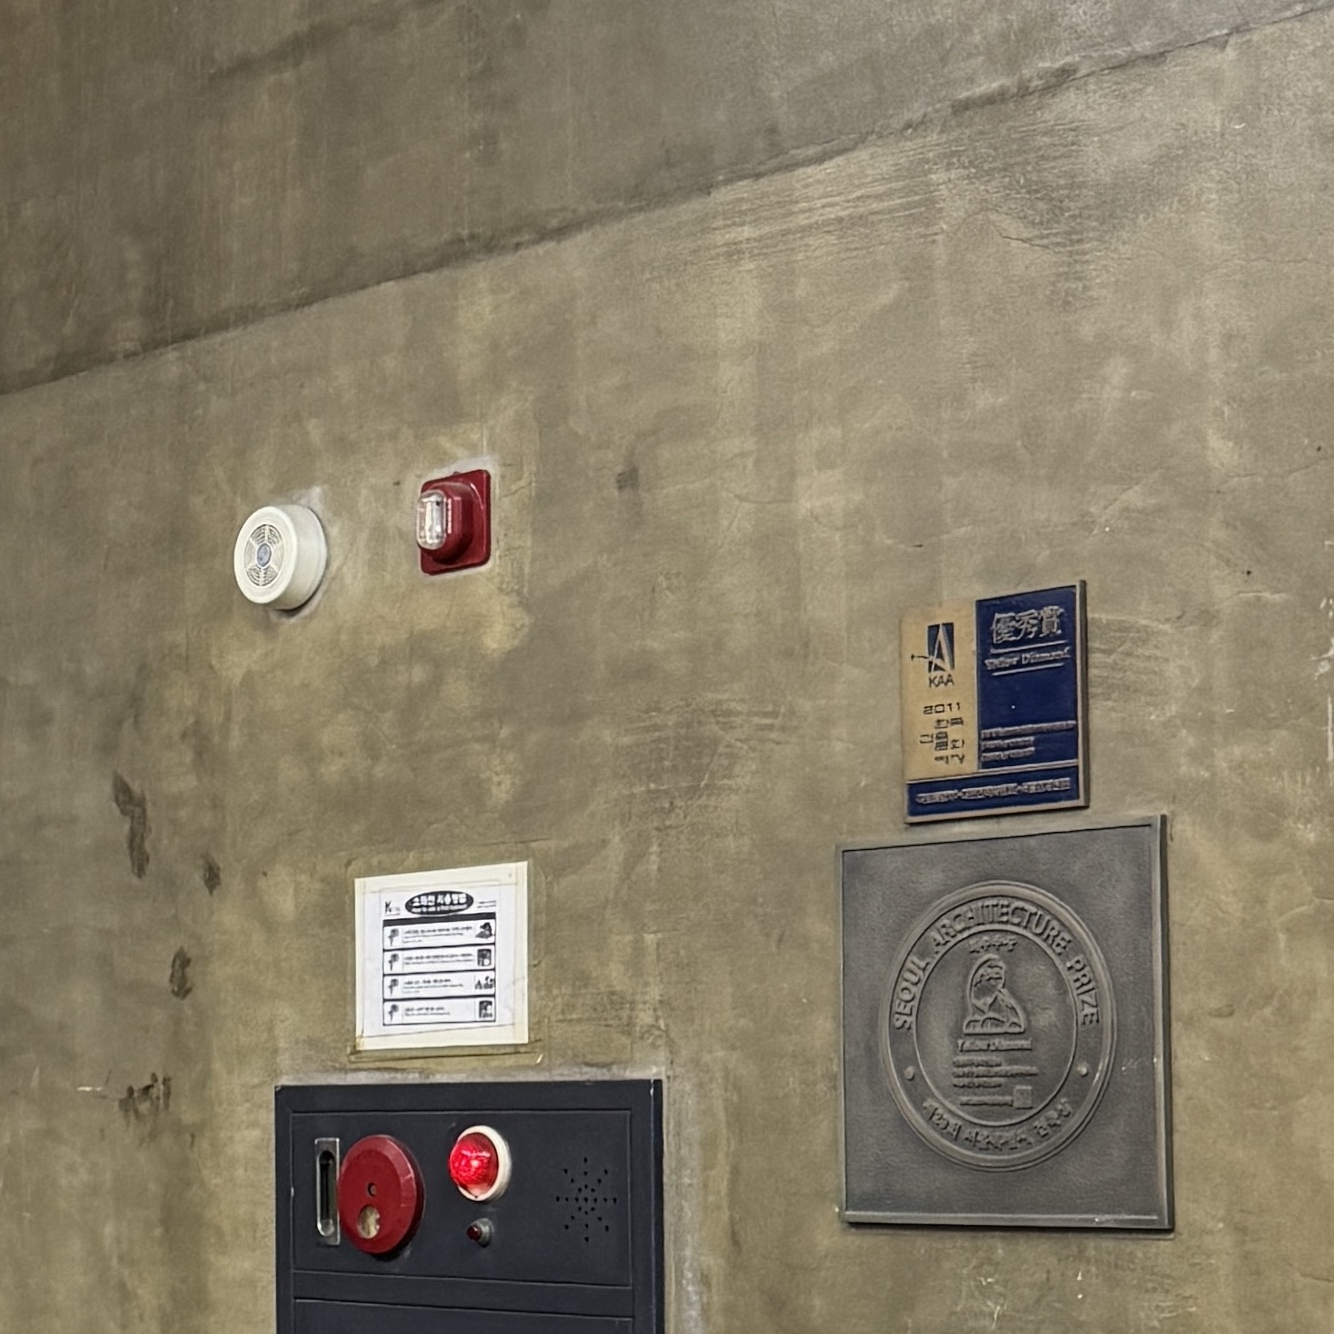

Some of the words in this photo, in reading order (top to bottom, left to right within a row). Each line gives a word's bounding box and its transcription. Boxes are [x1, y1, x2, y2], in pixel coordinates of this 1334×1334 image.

[923, 702, 961, 715] 2011
[893, 953, 931, 1032] SEOUL
[932, 901, 1073, 957] ARCHITECTURE
[1065, 954, 1102, 1027] PRIZE
